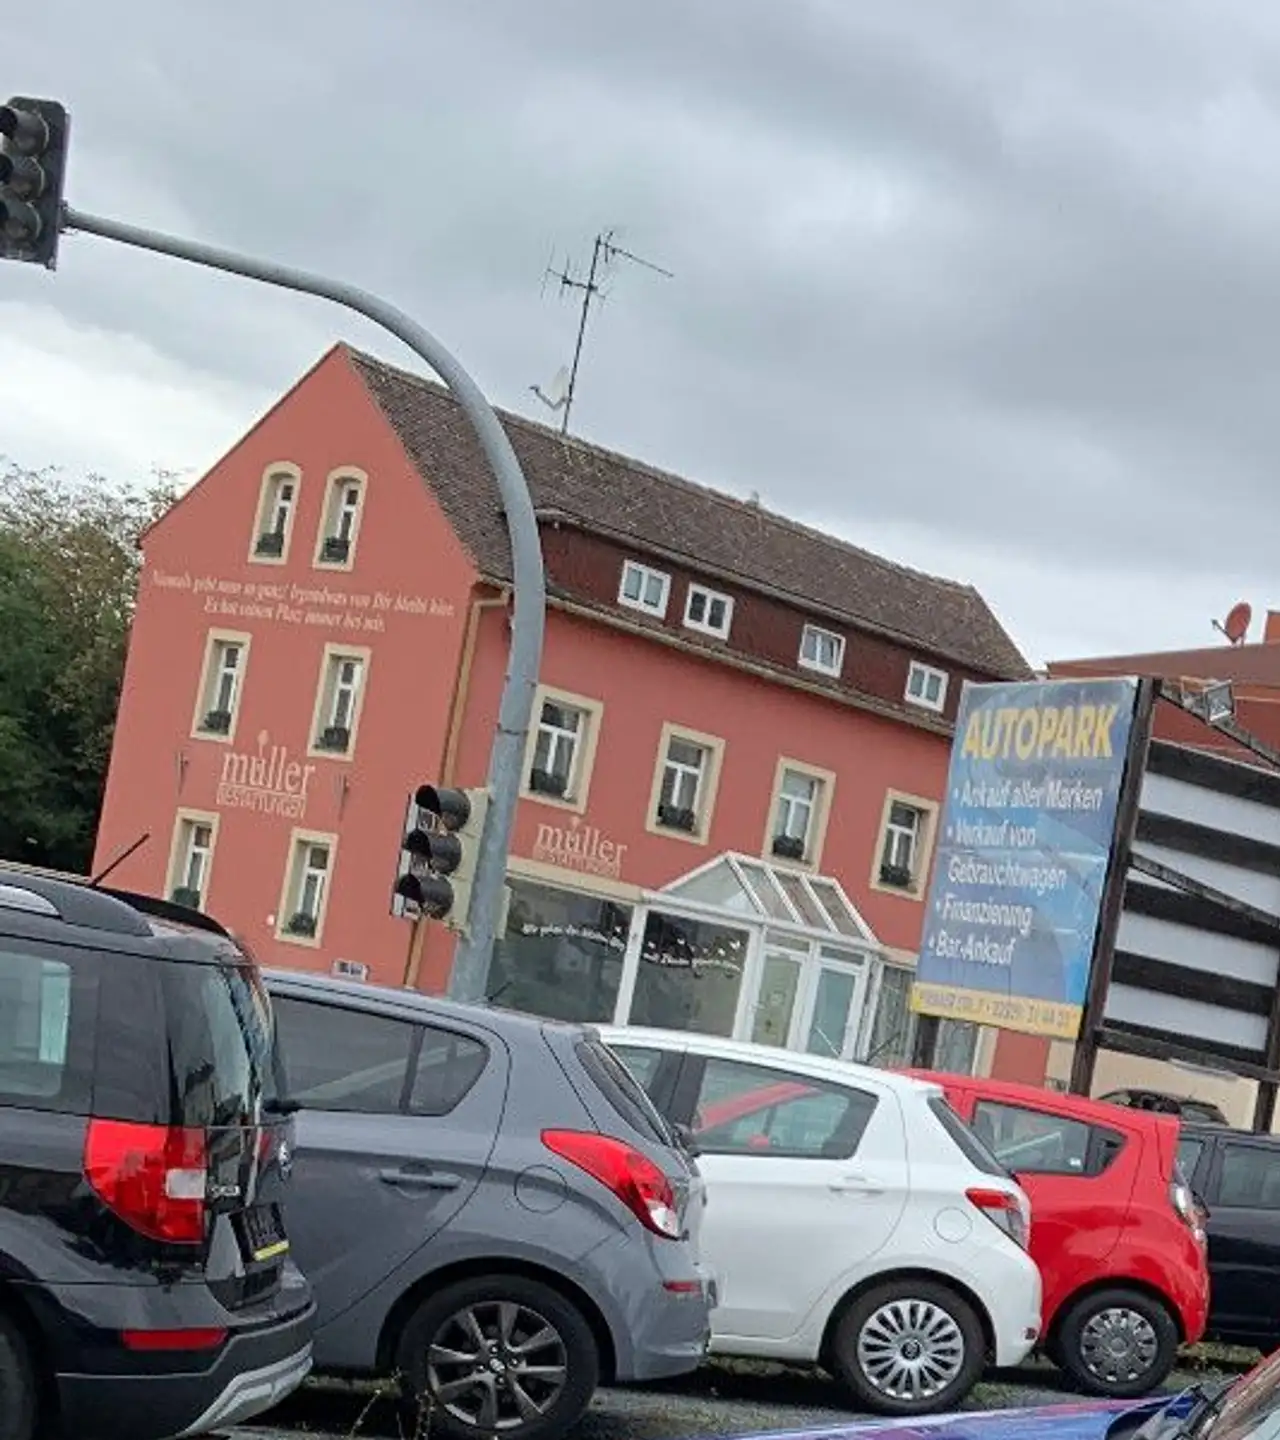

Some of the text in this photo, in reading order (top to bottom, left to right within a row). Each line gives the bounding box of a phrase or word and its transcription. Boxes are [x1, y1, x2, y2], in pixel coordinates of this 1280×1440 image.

[961, 705, 1118, 760] AUTOPARK
[960, 780, 1104, 811] Ankauf aller Marken
[1010, 826, 1036, 847] von
[948, 855, 1068, 897] Gebrauchtwagen
[942, 893, 1033, 939] Finanzierung
